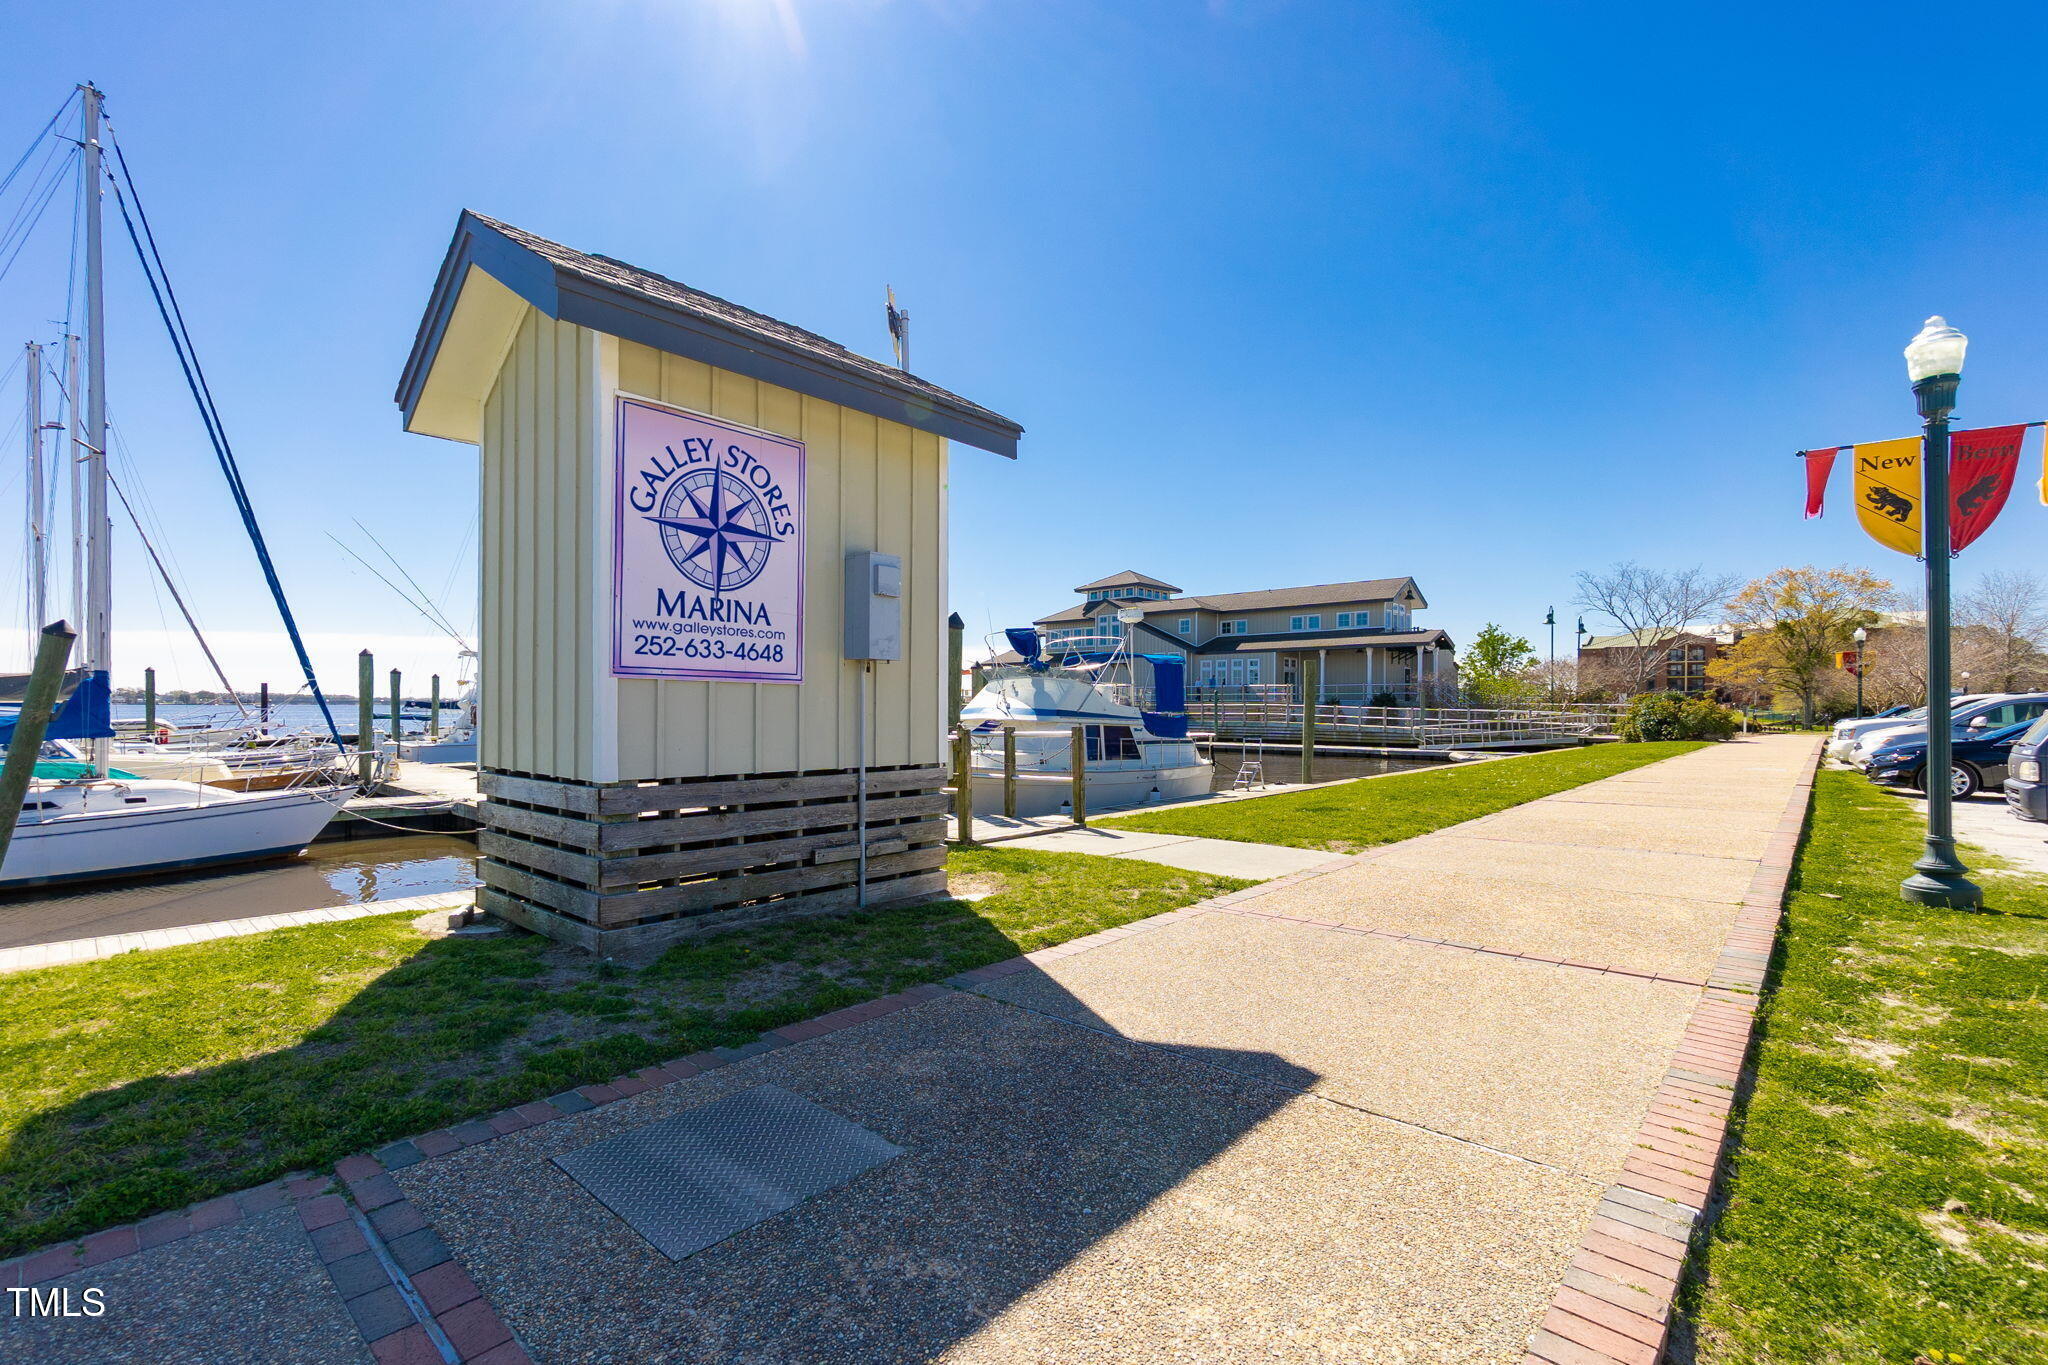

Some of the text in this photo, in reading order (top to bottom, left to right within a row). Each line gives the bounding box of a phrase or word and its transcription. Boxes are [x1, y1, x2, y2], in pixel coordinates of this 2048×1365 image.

[1859, 455, 1917, 472] New
[630, 437, 795, 536] GALLEY STORES
[656, 588, 772, 627] MARINA
[633, 619, 786, 641] www.galleystores.com
[634, 635, 784, 663] 252-633-4648
